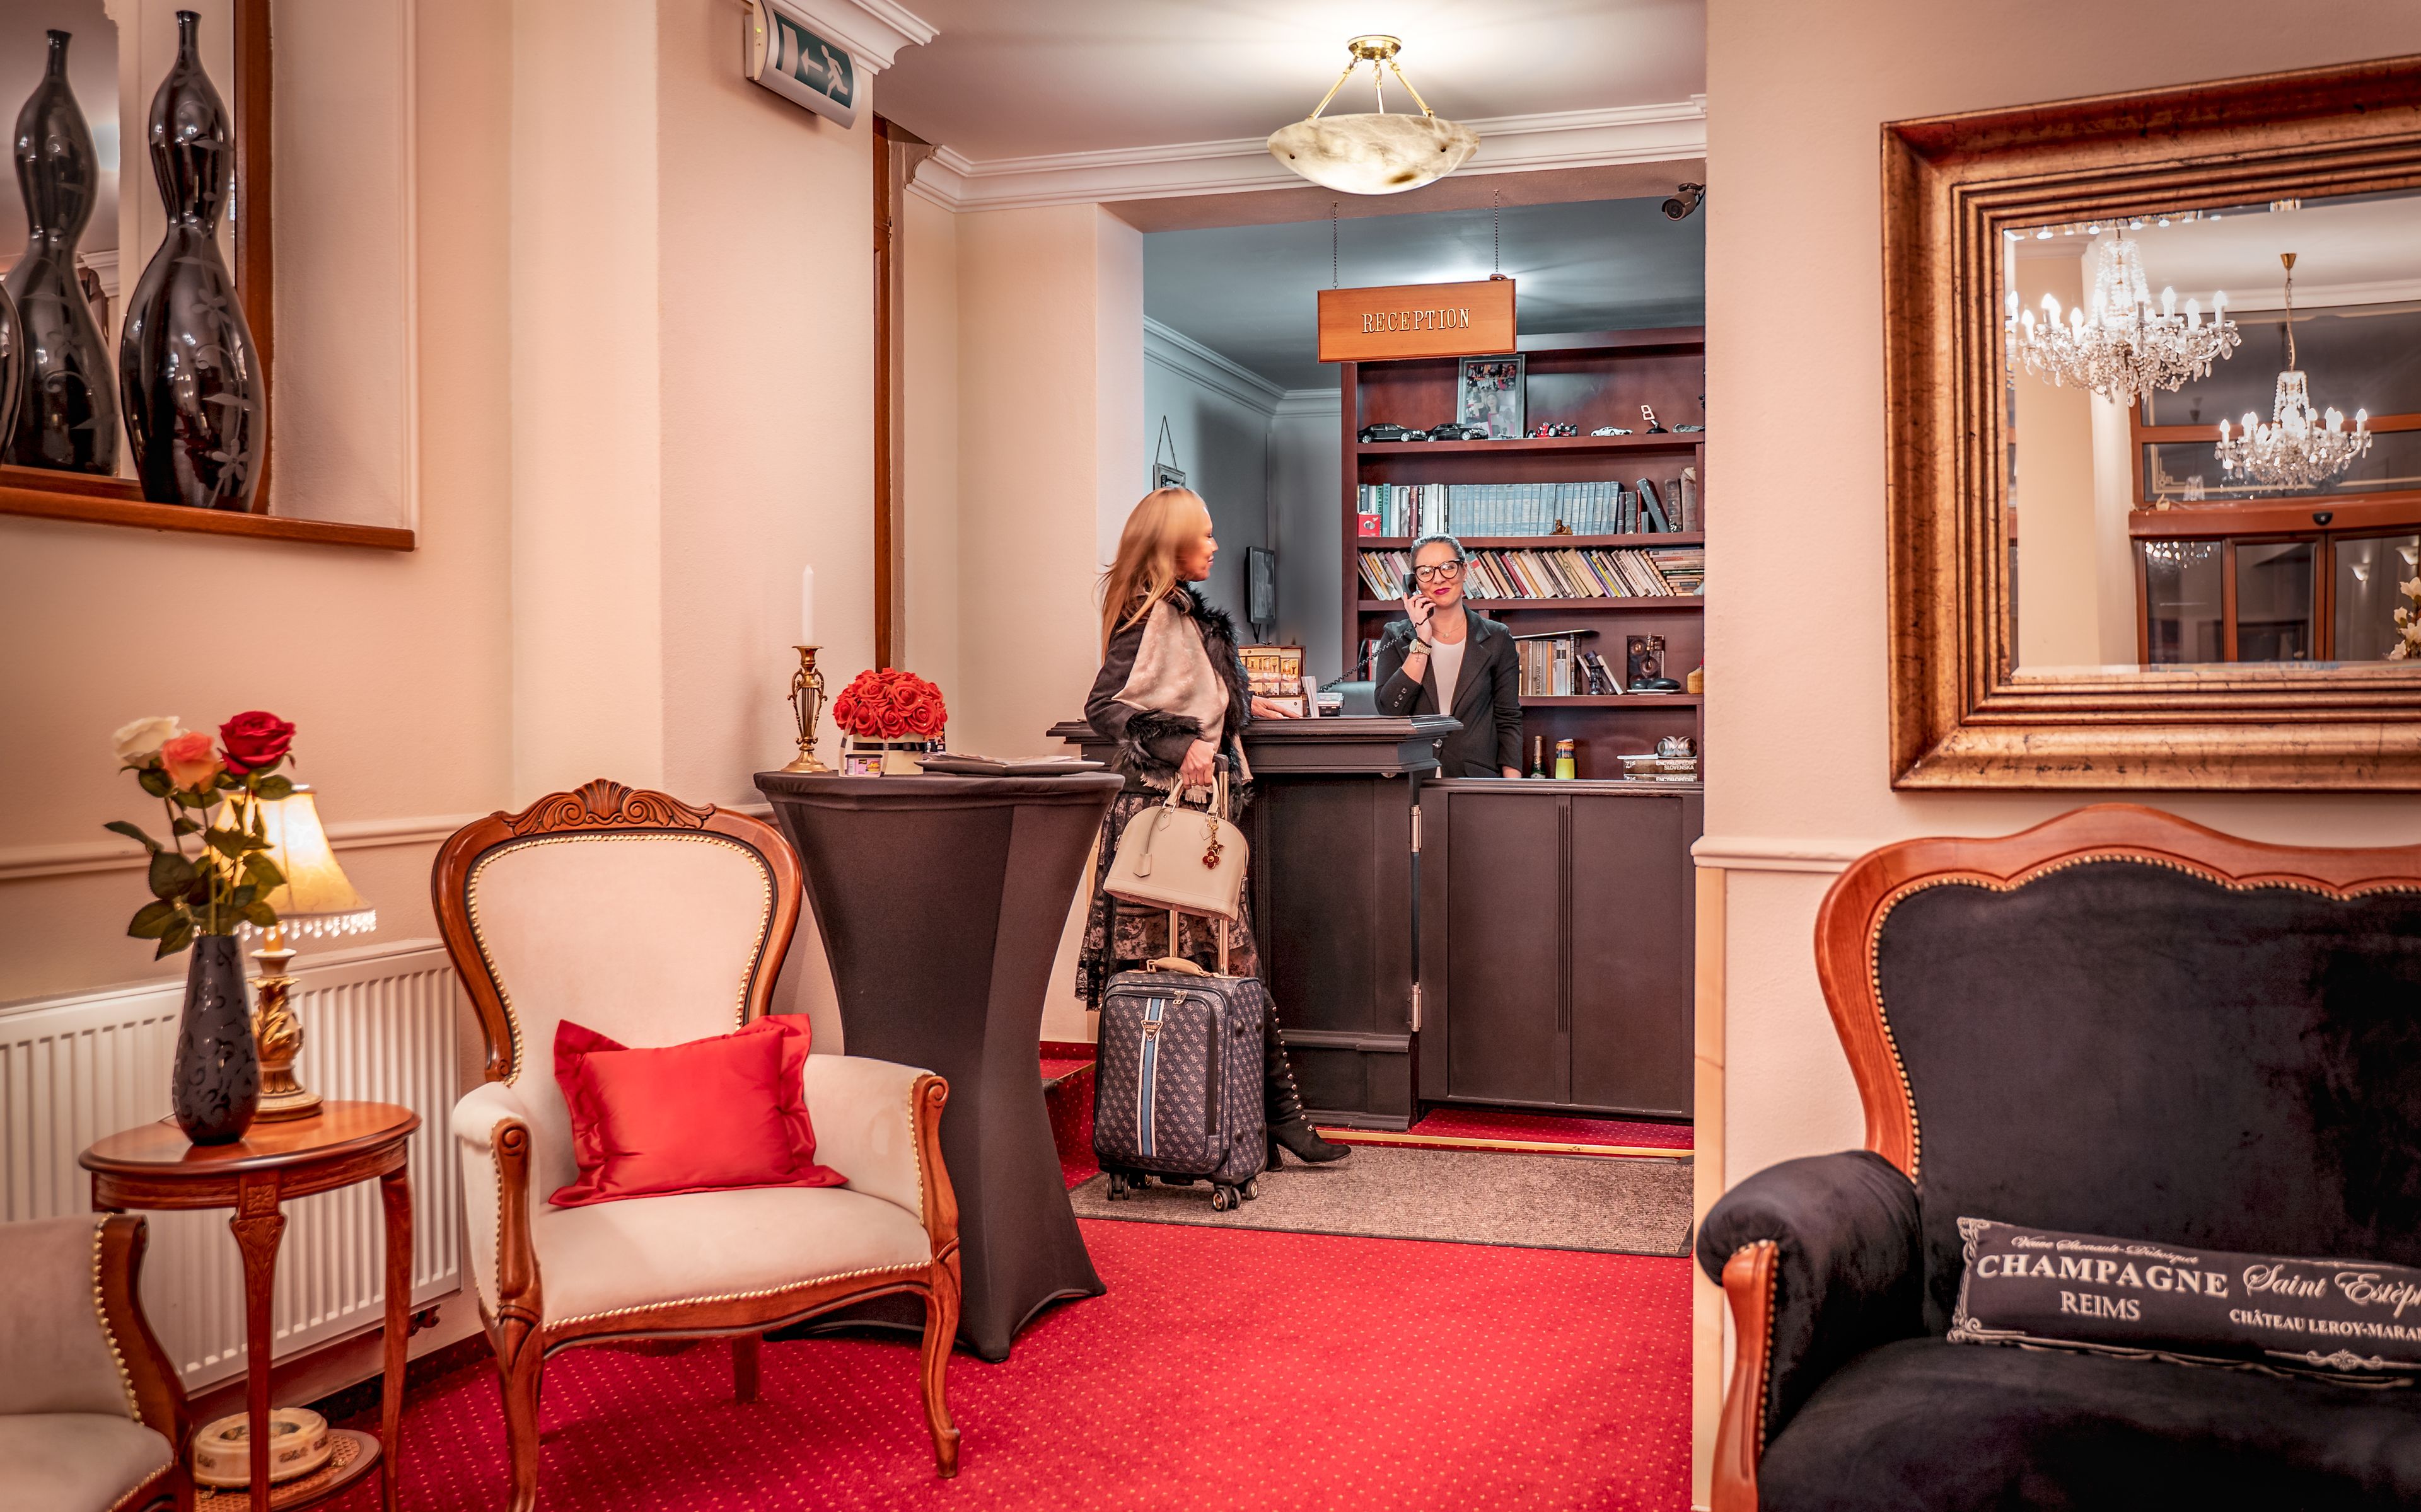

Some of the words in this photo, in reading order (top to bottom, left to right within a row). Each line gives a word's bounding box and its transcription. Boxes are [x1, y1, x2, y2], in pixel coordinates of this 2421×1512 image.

[1362, 308, 1470, 333] RECEPTION
[1977, 1254, 2229, 1299] CHAMPAGNE
[2243, 1264, 2328, 1298] Saint
[2060, 1290, 2141, 1321] REIMS
[2229, 1308, 2307, 1332] CHÂTEAU
